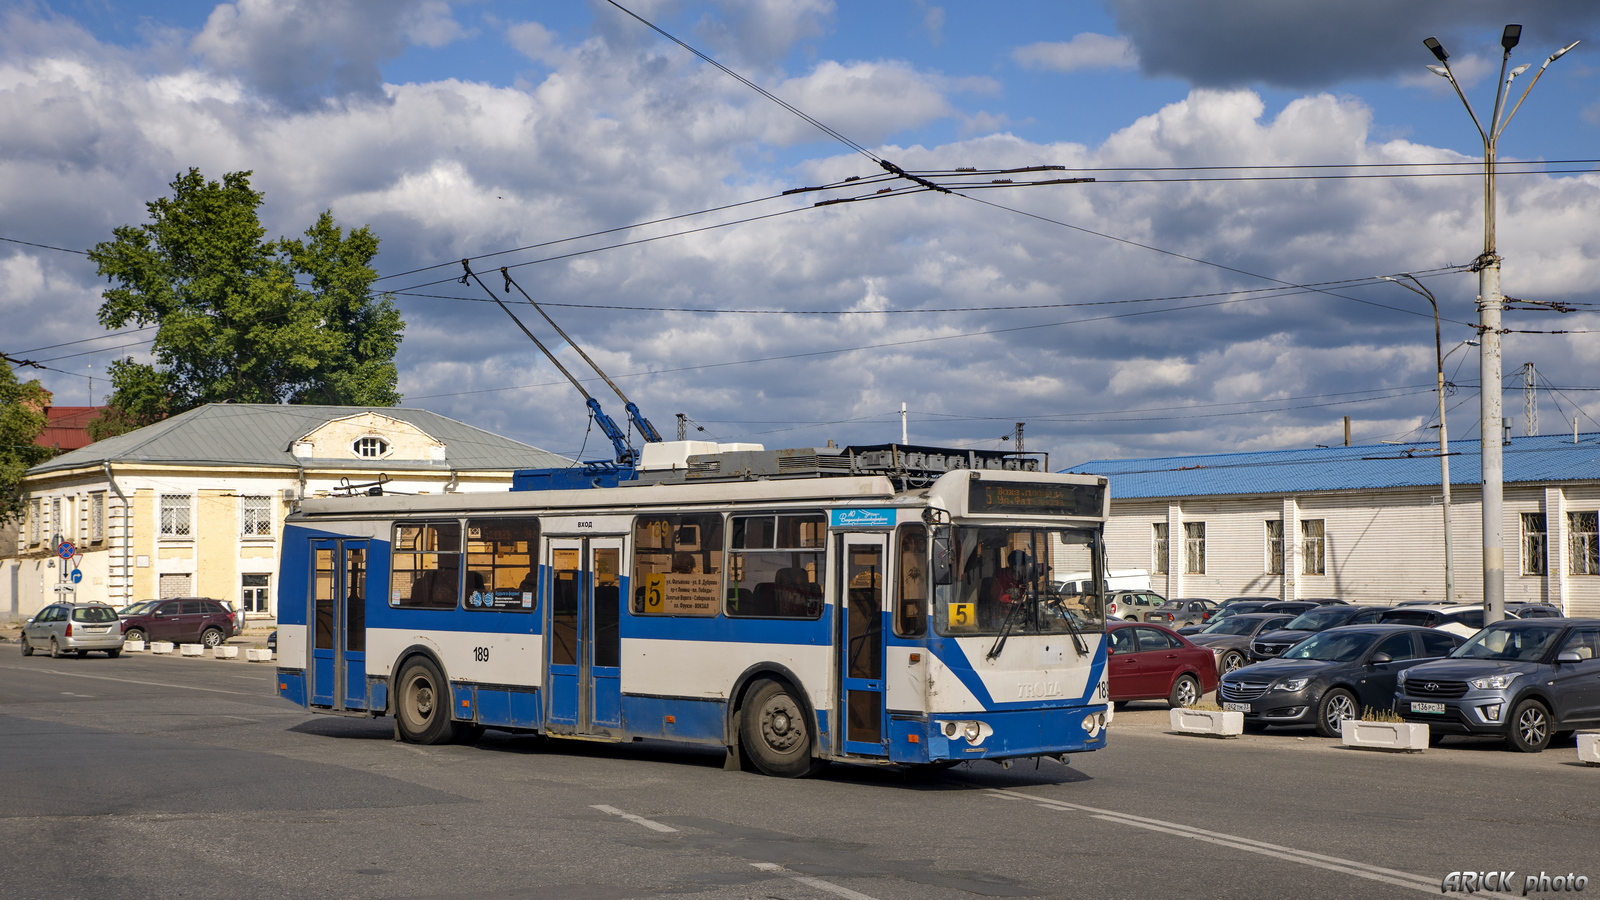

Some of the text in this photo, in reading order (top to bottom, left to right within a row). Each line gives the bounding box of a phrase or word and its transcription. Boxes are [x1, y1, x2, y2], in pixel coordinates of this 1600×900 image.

[646, 520, 669, 537] 189
[649, 580, 661, 607] 5
[956, 604, 967, 626] 5
[473, 646, 489, 662] 189
[1096, 681, 1109, 699] 18
